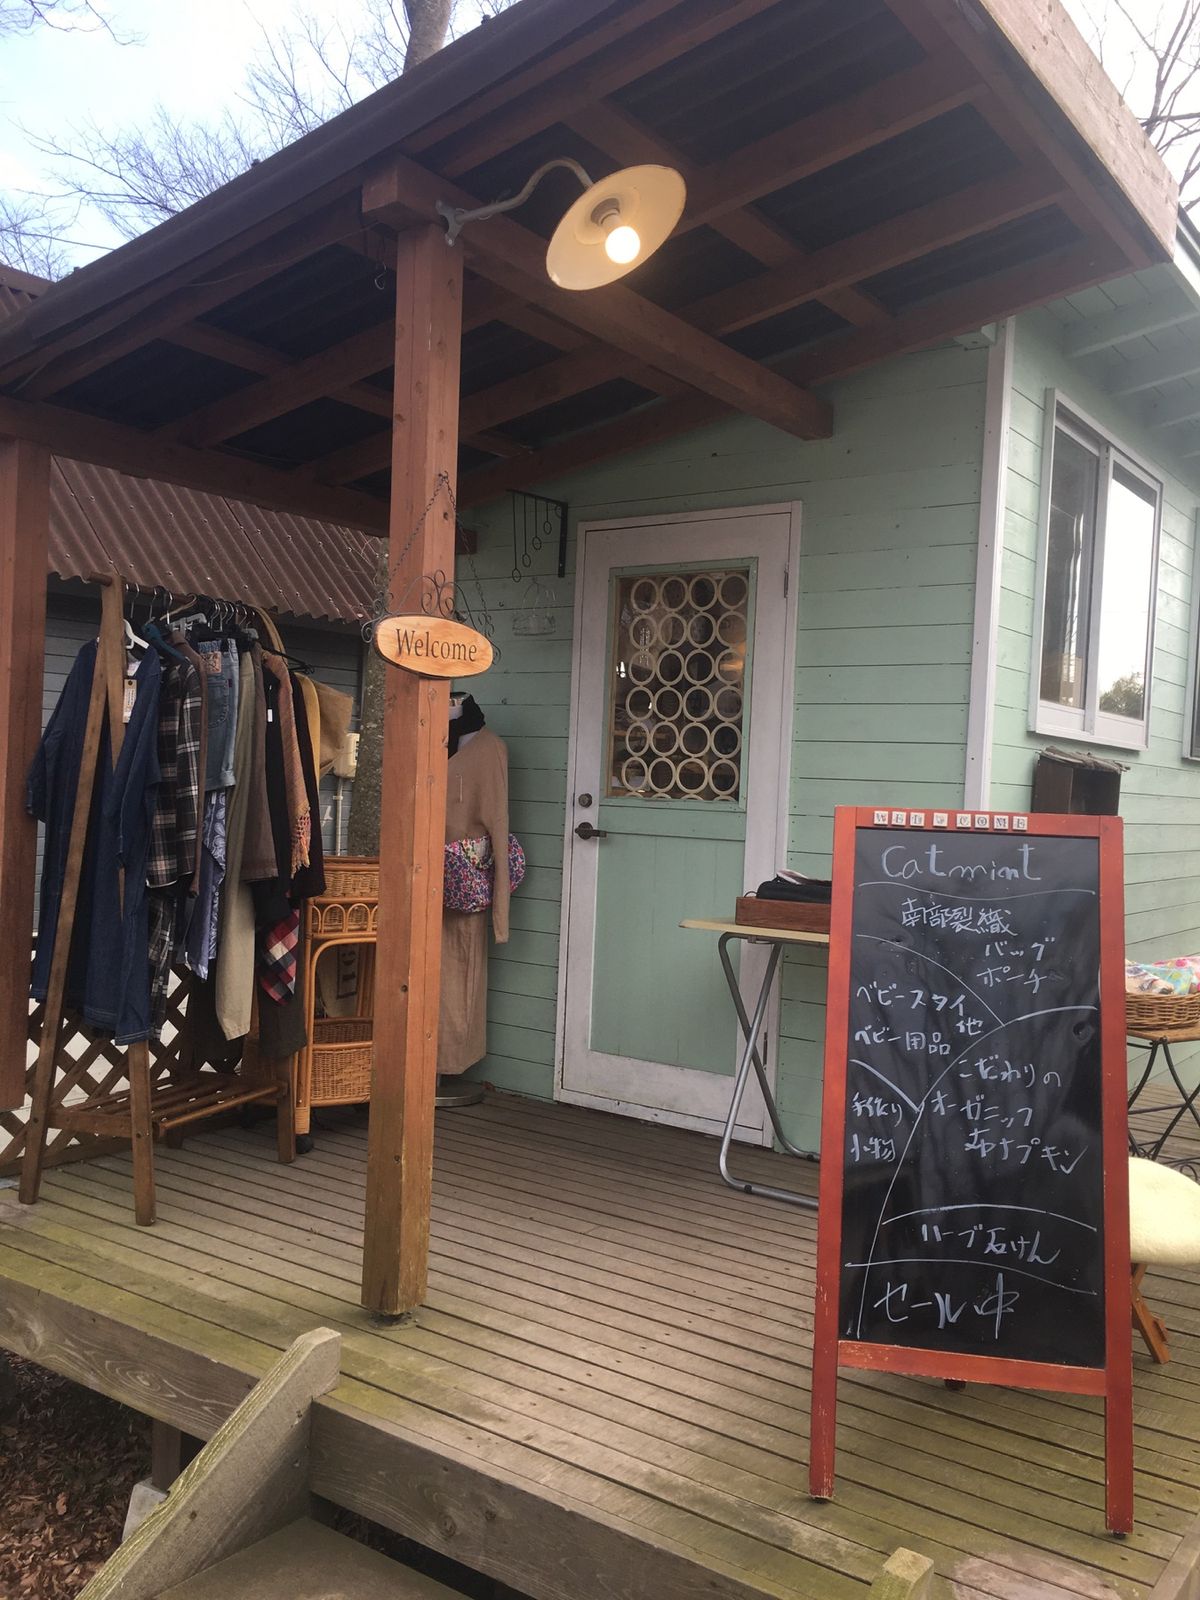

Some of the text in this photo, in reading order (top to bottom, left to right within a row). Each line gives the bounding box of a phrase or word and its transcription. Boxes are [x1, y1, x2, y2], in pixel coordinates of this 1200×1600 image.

[396, 628, 478, 662] Welcome
[881, 844, 1042, 881] Catmint
[985, 936, 1056, 962] バッグ
[976, 965, 1048, 994] ポーチ
[856, 980, 966, 1017] ベビースタイ
[854, 1024, 951, 1055] ベビー用品
[958, 1054, 1062, 1088] こだわりの
[930, 1090, 1033, 1128] オーガニック
[921, 1223, 1061, 1265] ハーブ石けん
[873, 1272, 1020, 1340] セール中
